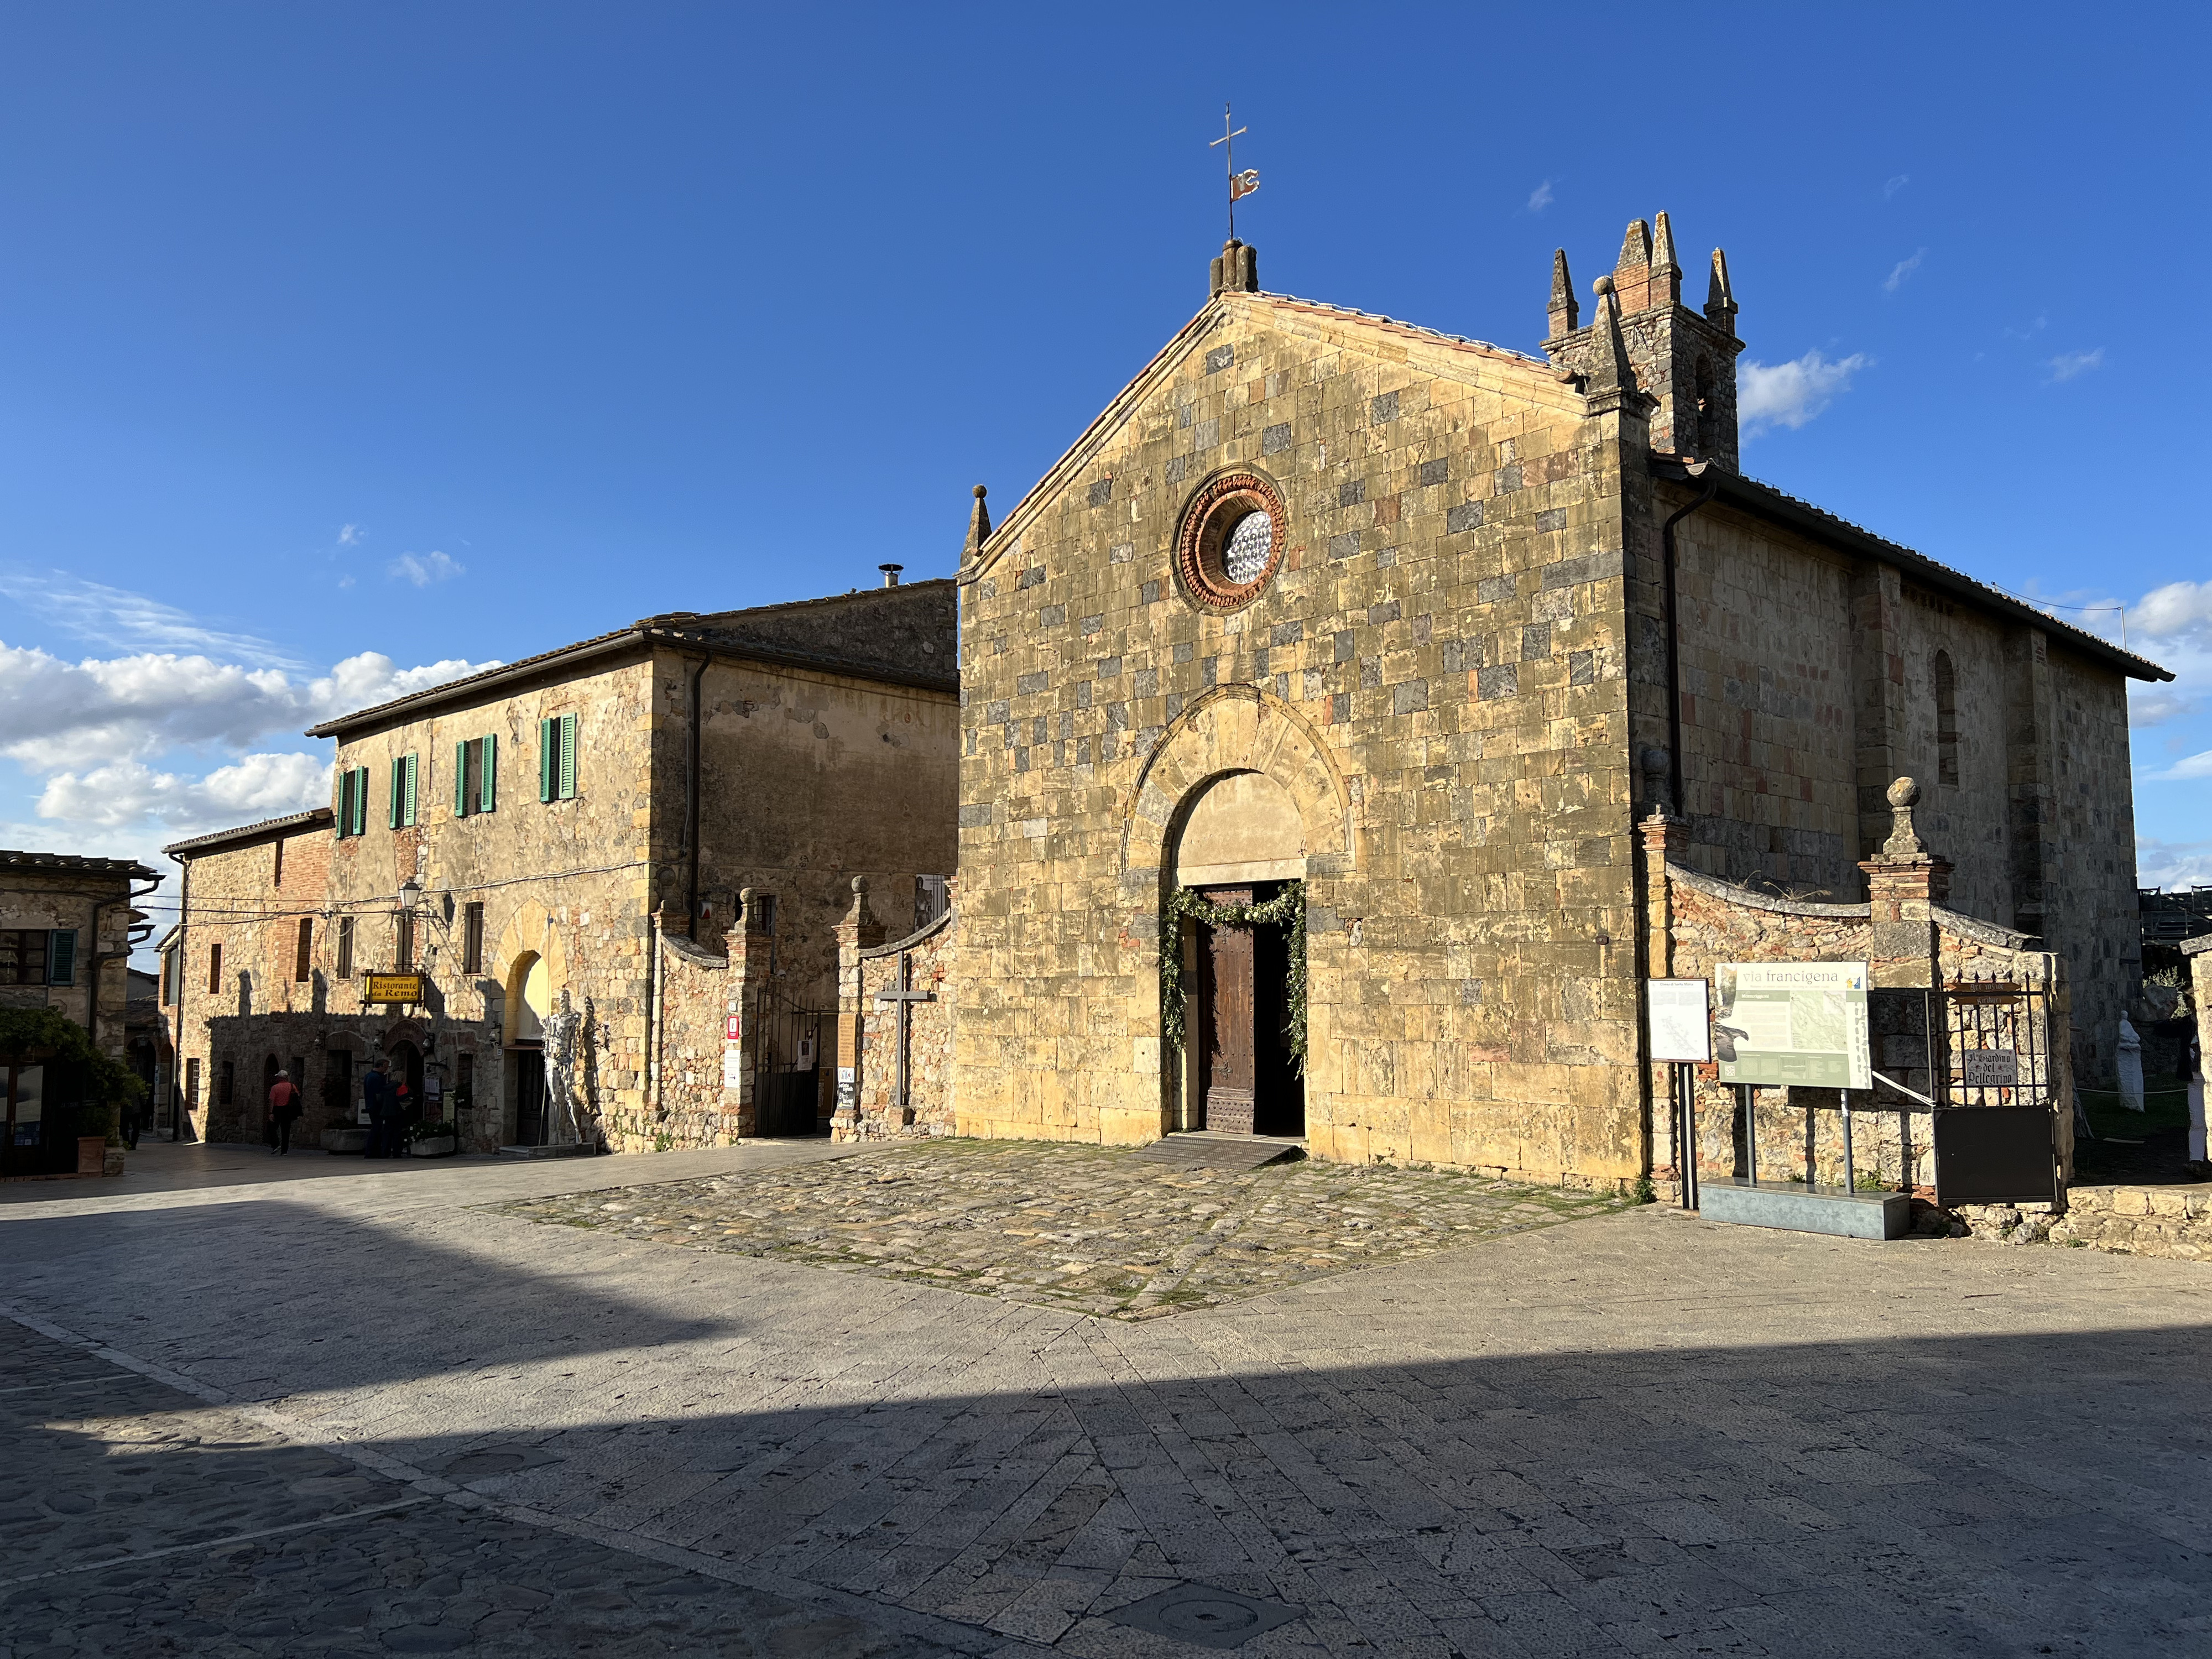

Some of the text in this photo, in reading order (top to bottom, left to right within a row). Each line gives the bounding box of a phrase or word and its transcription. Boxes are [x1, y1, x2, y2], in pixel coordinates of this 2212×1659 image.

[1743, 970, 1838, 984] via francigena
[1967, 1052, 2010, 1065] Il Giardino
[1983, 1063, 1995, 1072] del
[1968, 1072, 2012, 1084] Pellegrino
